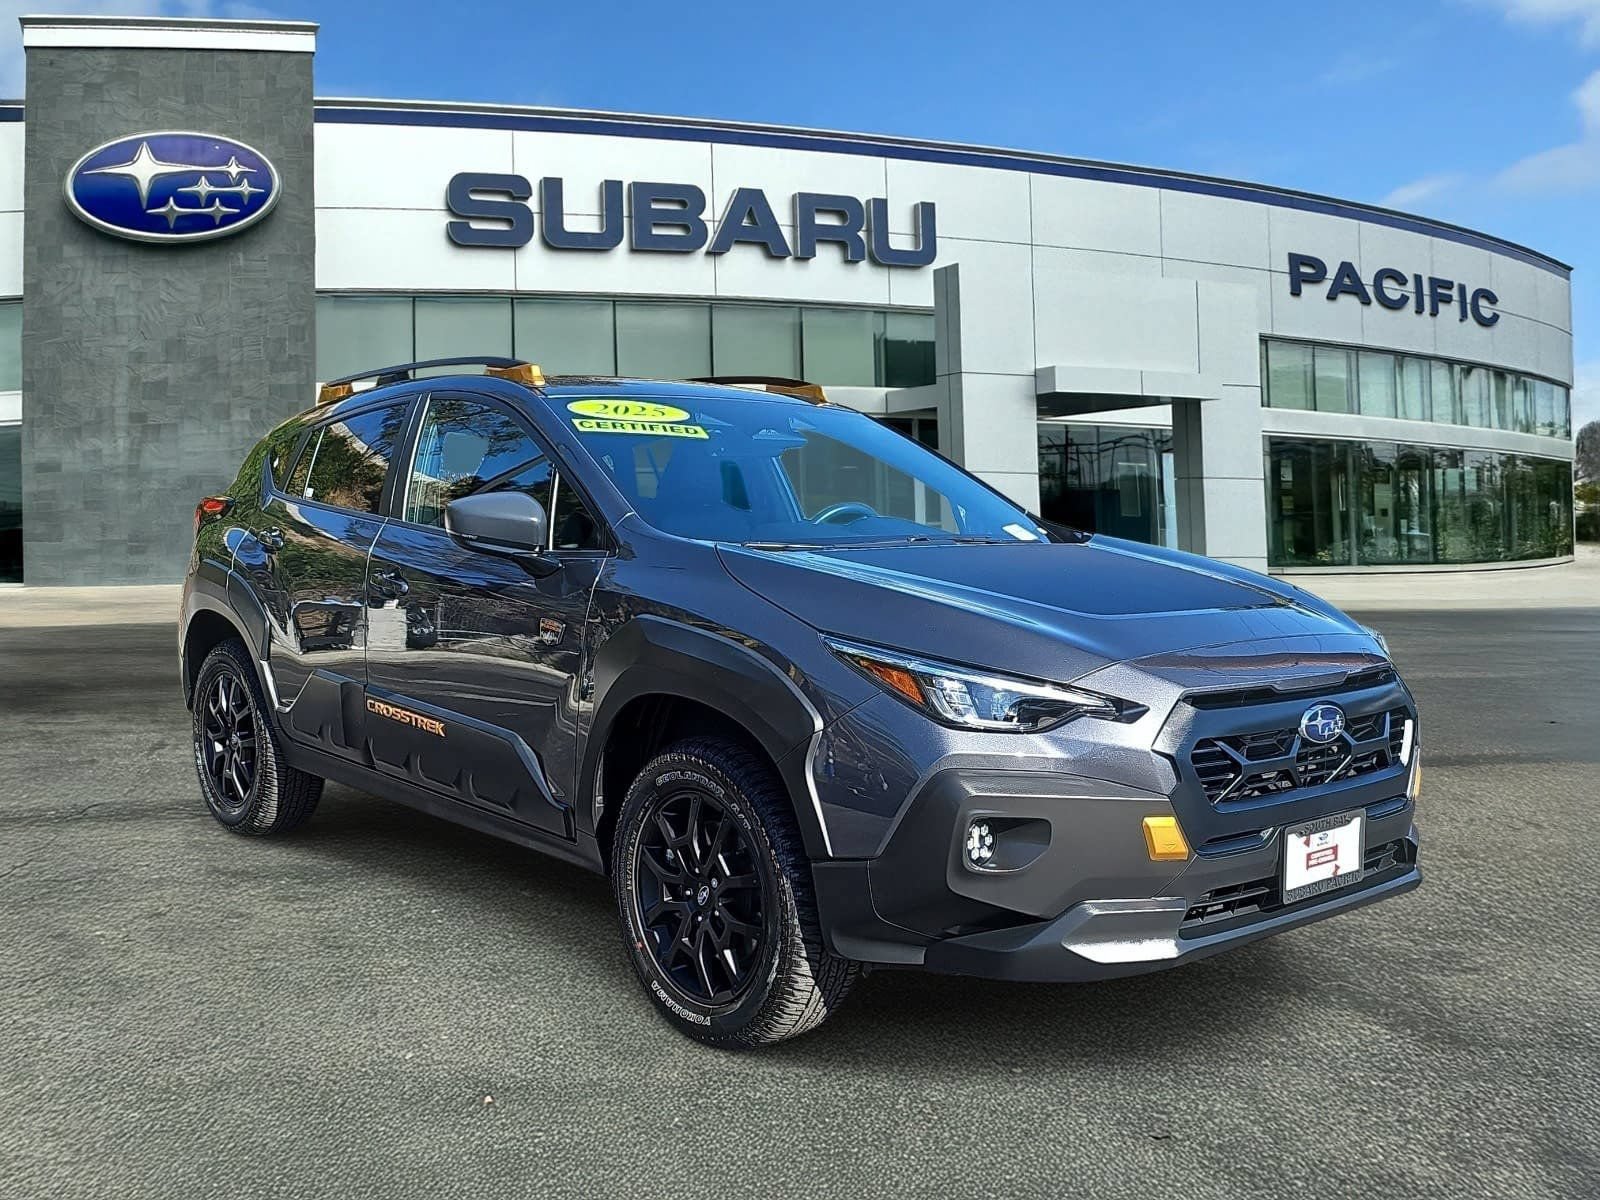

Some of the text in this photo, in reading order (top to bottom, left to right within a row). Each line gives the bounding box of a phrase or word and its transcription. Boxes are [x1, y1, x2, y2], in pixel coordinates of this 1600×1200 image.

[446, 171, 937, 268] SUBARU
[1287, 251, 1501, 328] PACIFIC
[578, 420, 699, 436] CERTIFIED
[594, 403, 666, 417] 2025
[366, 699, 447, 738] CROSSTREK
[651, 979, 712, 1026] YOKOHAMA
